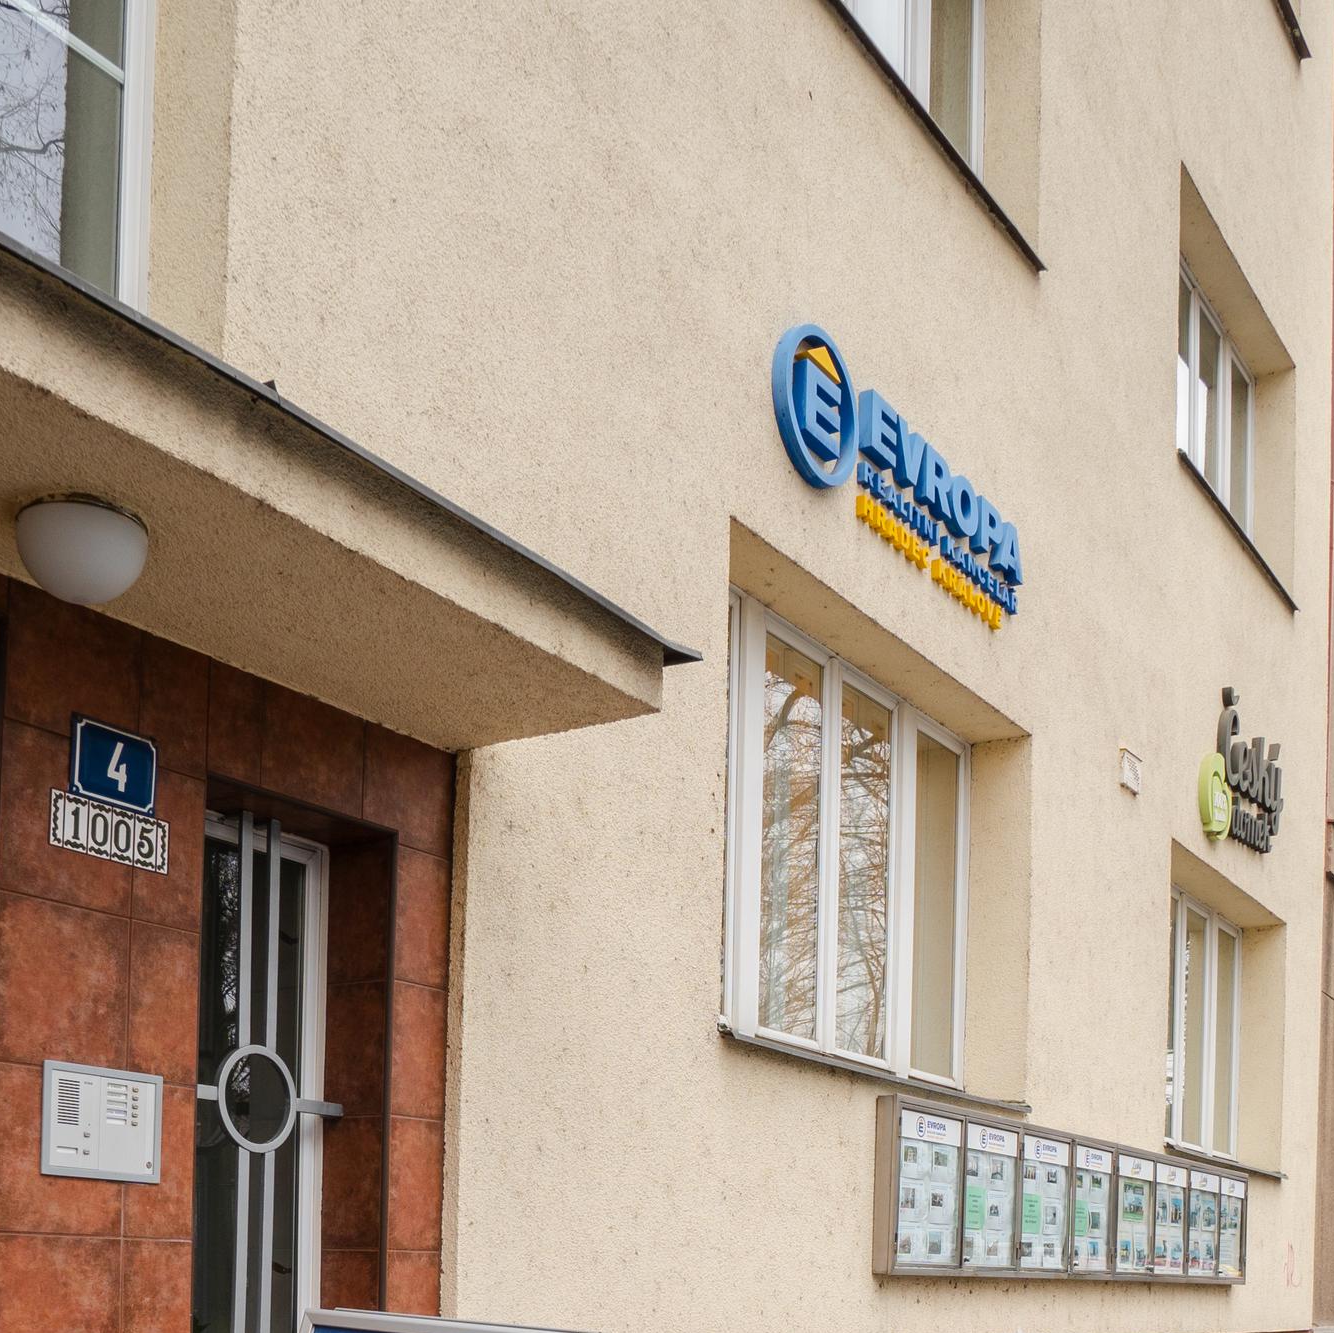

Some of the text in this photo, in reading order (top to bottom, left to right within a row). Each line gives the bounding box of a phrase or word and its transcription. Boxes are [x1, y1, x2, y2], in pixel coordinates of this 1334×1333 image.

[858, 389, 1022, 586] EVROPA
[856, 494, 930, 569] HRADEC
[107, 741, 127, 793] 4
[1217, 686, 1283, 836] Český
[71, 806, 155, 859] 1005
[927, 1120, 947, 1132] EVROPA
